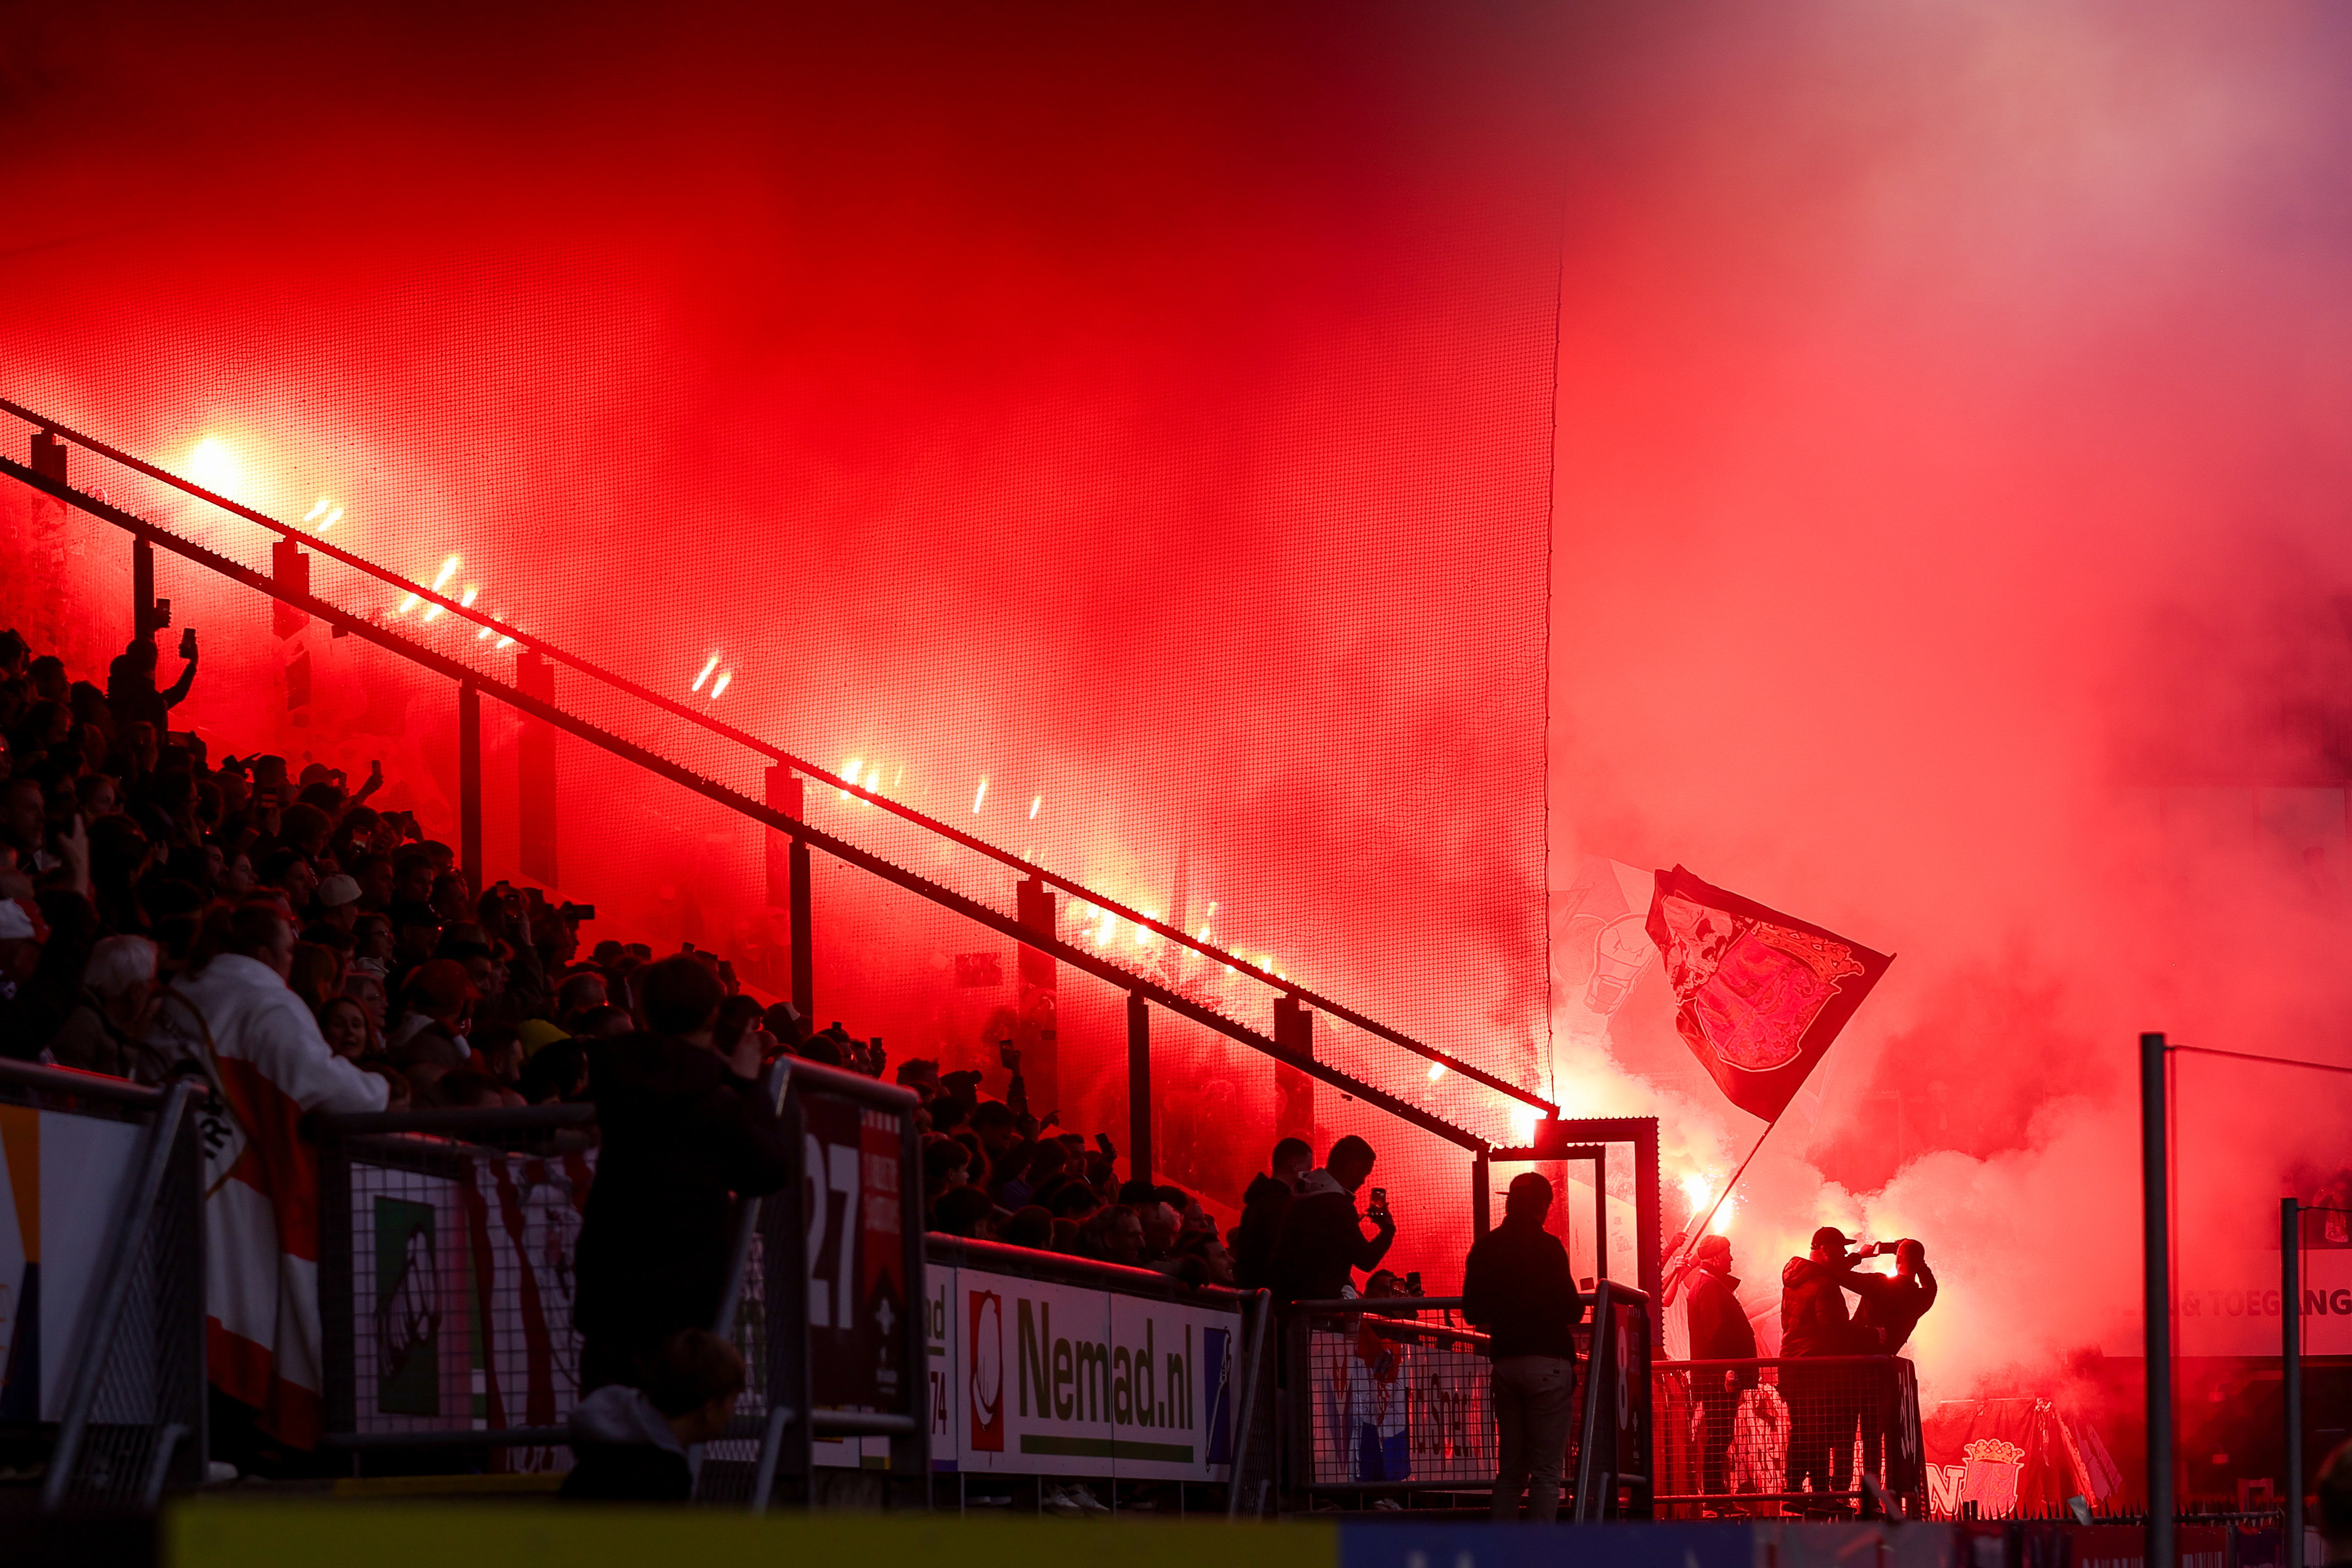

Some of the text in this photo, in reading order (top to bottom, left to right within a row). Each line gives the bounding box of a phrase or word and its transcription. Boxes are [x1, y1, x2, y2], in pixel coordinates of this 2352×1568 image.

[804, 1132, 860, 1329] 27
[1018, 1298, 1193, 1429] Nemad.nl
[2207, 1290, 2352, 1316] TOEGNG
